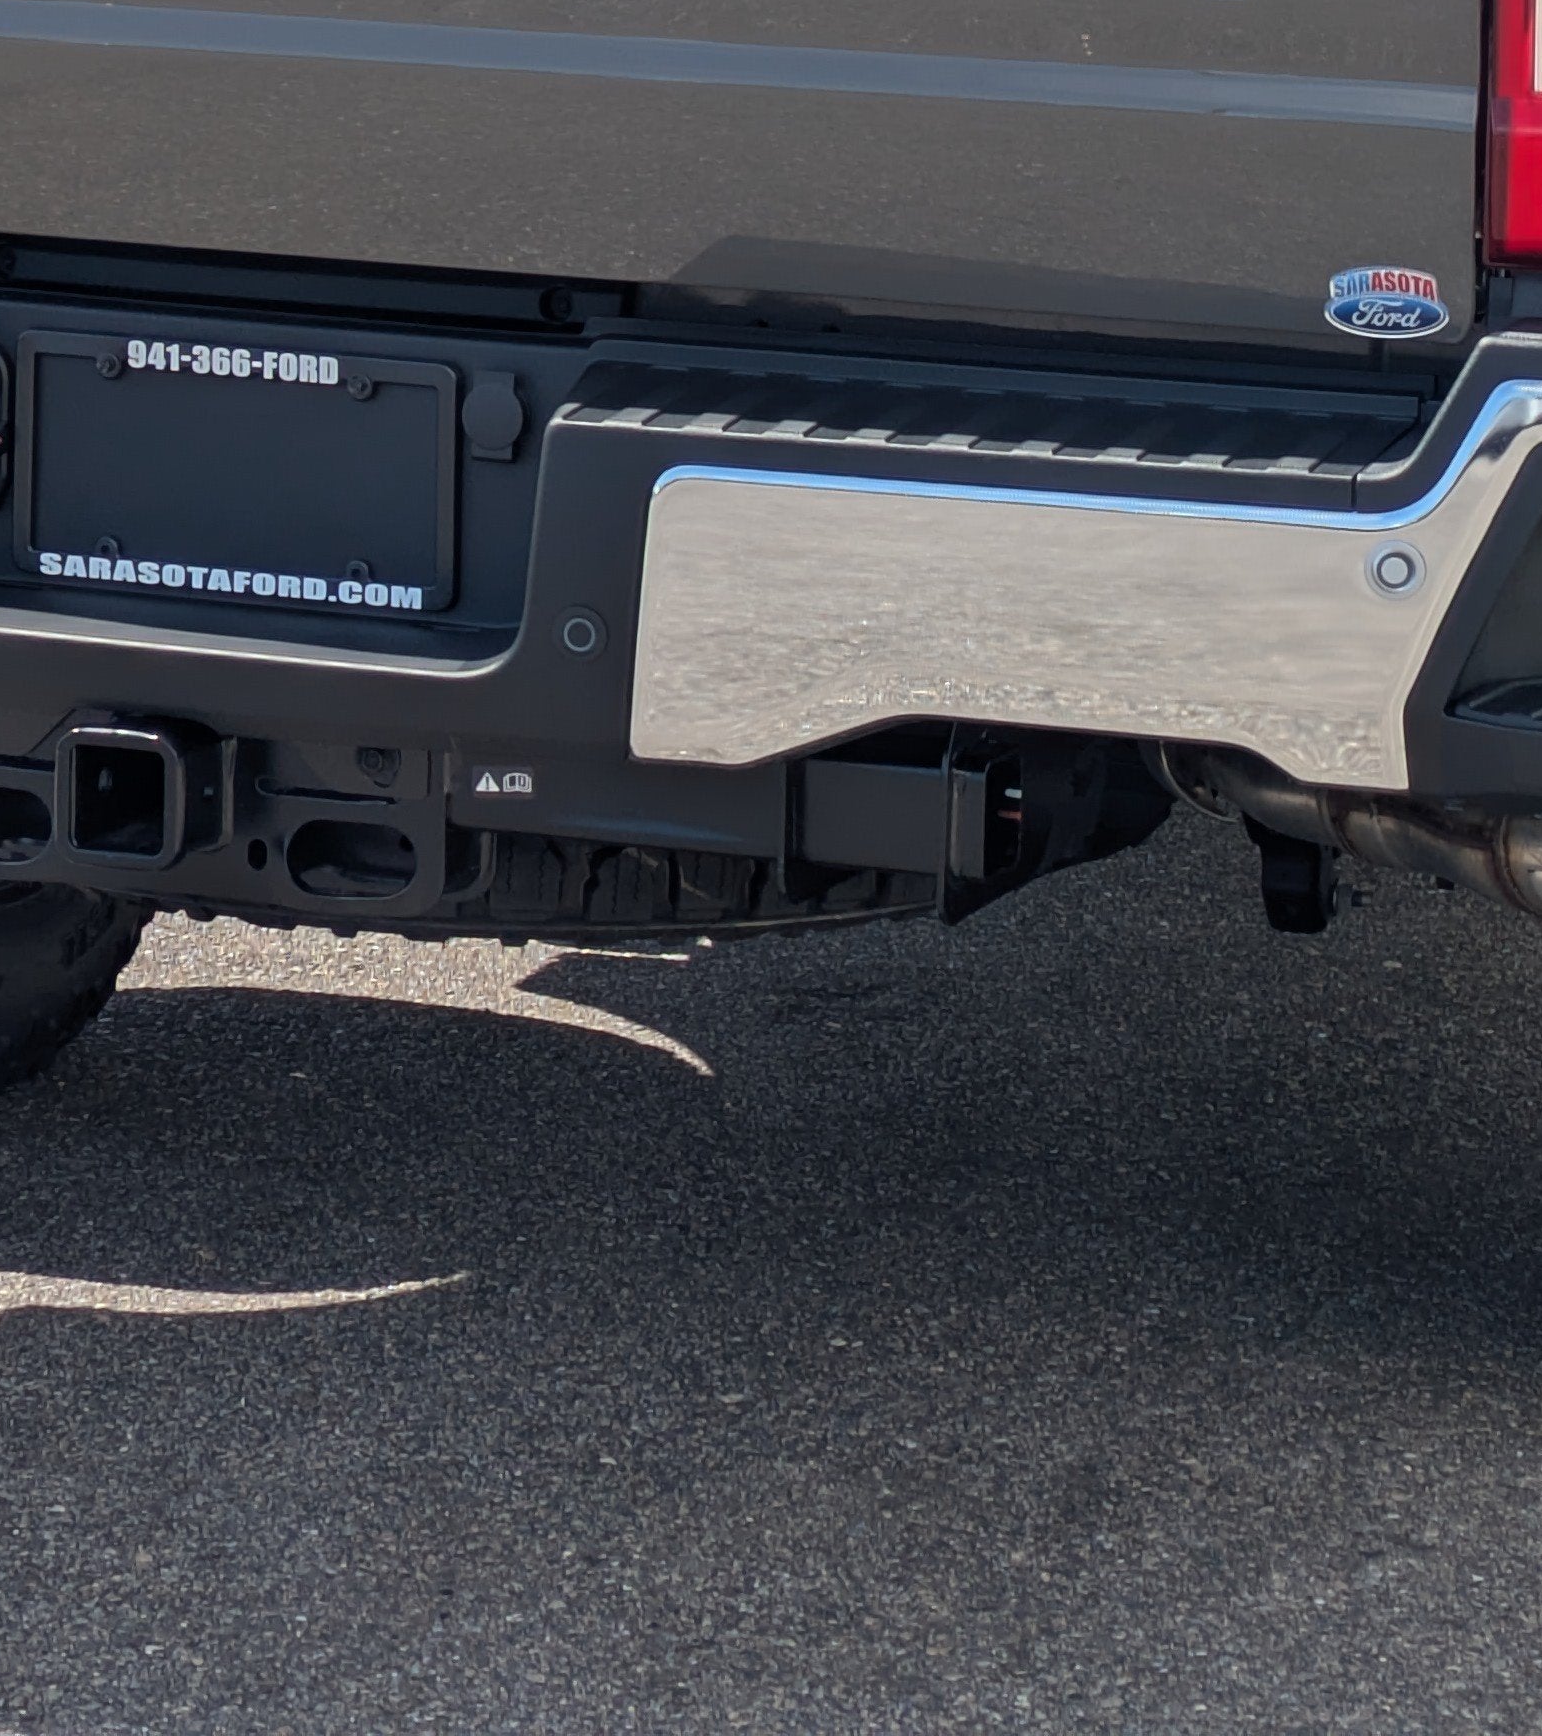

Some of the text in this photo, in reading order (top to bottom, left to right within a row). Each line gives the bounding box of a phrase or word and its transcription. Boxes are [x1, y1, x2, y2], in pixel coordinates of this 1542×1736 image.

[1334, 270, 1437, 302] SARASOTA
[1352, 298, 1421, 328] Ford
[127, 340, 339, 385] 941-366-FORD
[39, 551, 424, 611] SARASOTAFORD.COM
